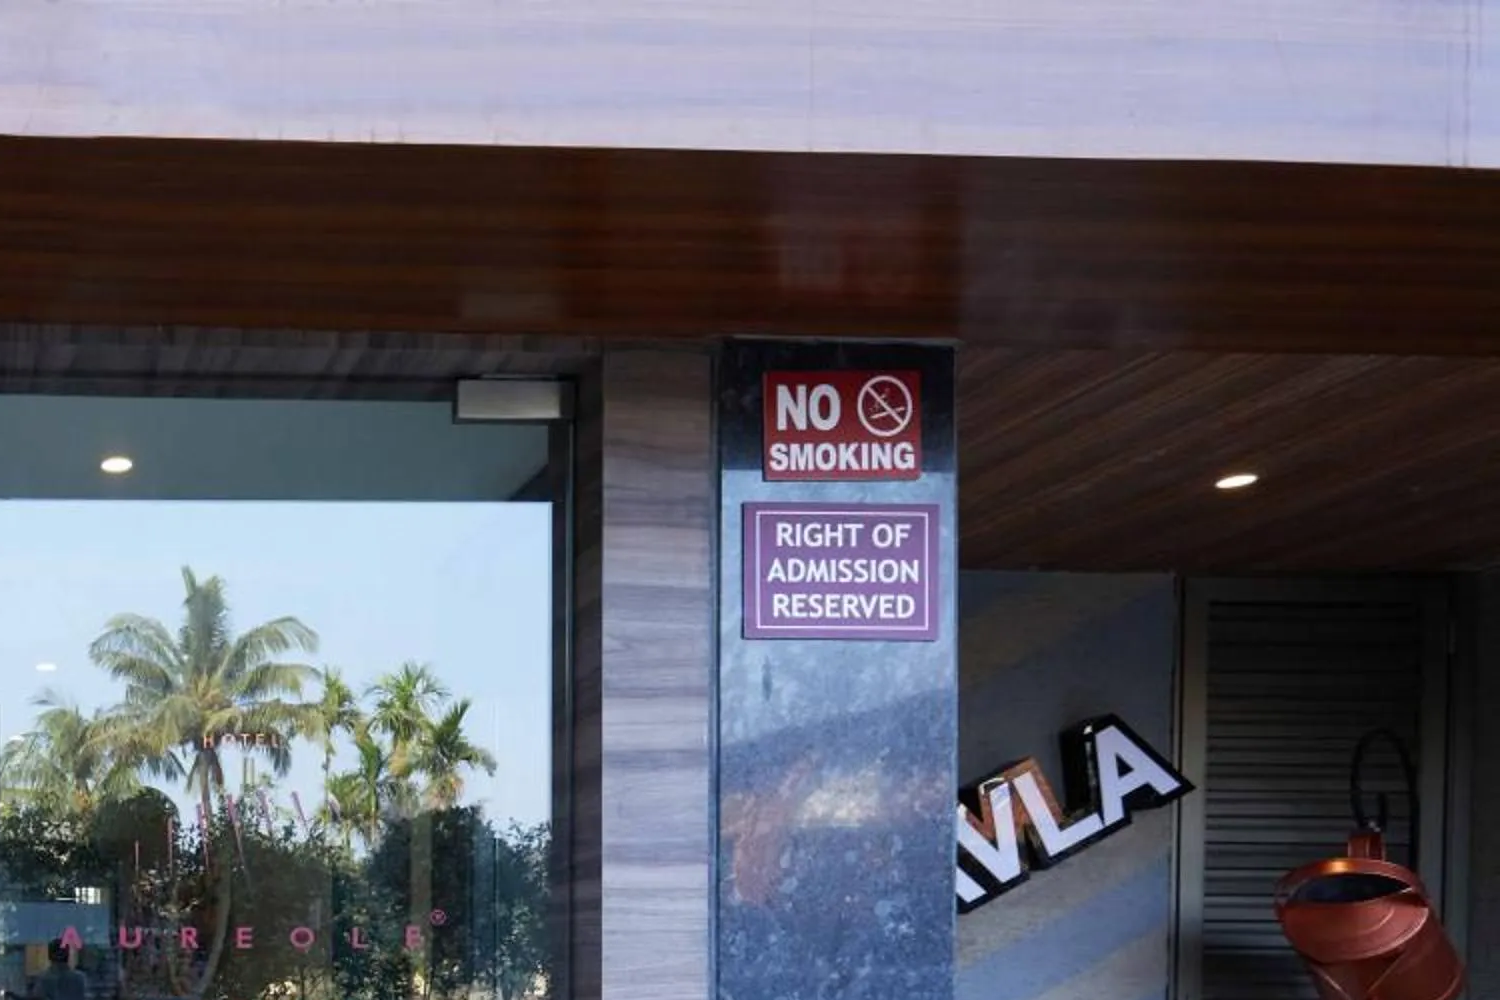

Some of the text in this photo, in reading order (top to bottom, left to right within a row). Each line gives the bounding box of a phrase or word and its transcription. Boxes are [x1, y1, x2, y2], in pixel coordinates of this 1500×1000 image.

[775, 384, 841, 431] NO
[769, 441, 916, 472] SMOKING
[775, 523, 911, 547] RIGHT OF
[767, 558, 920, 584] ADMISSION
[771, 593, 916, 620] RESERVED
[202, 732, 281, 749] HOTEL
